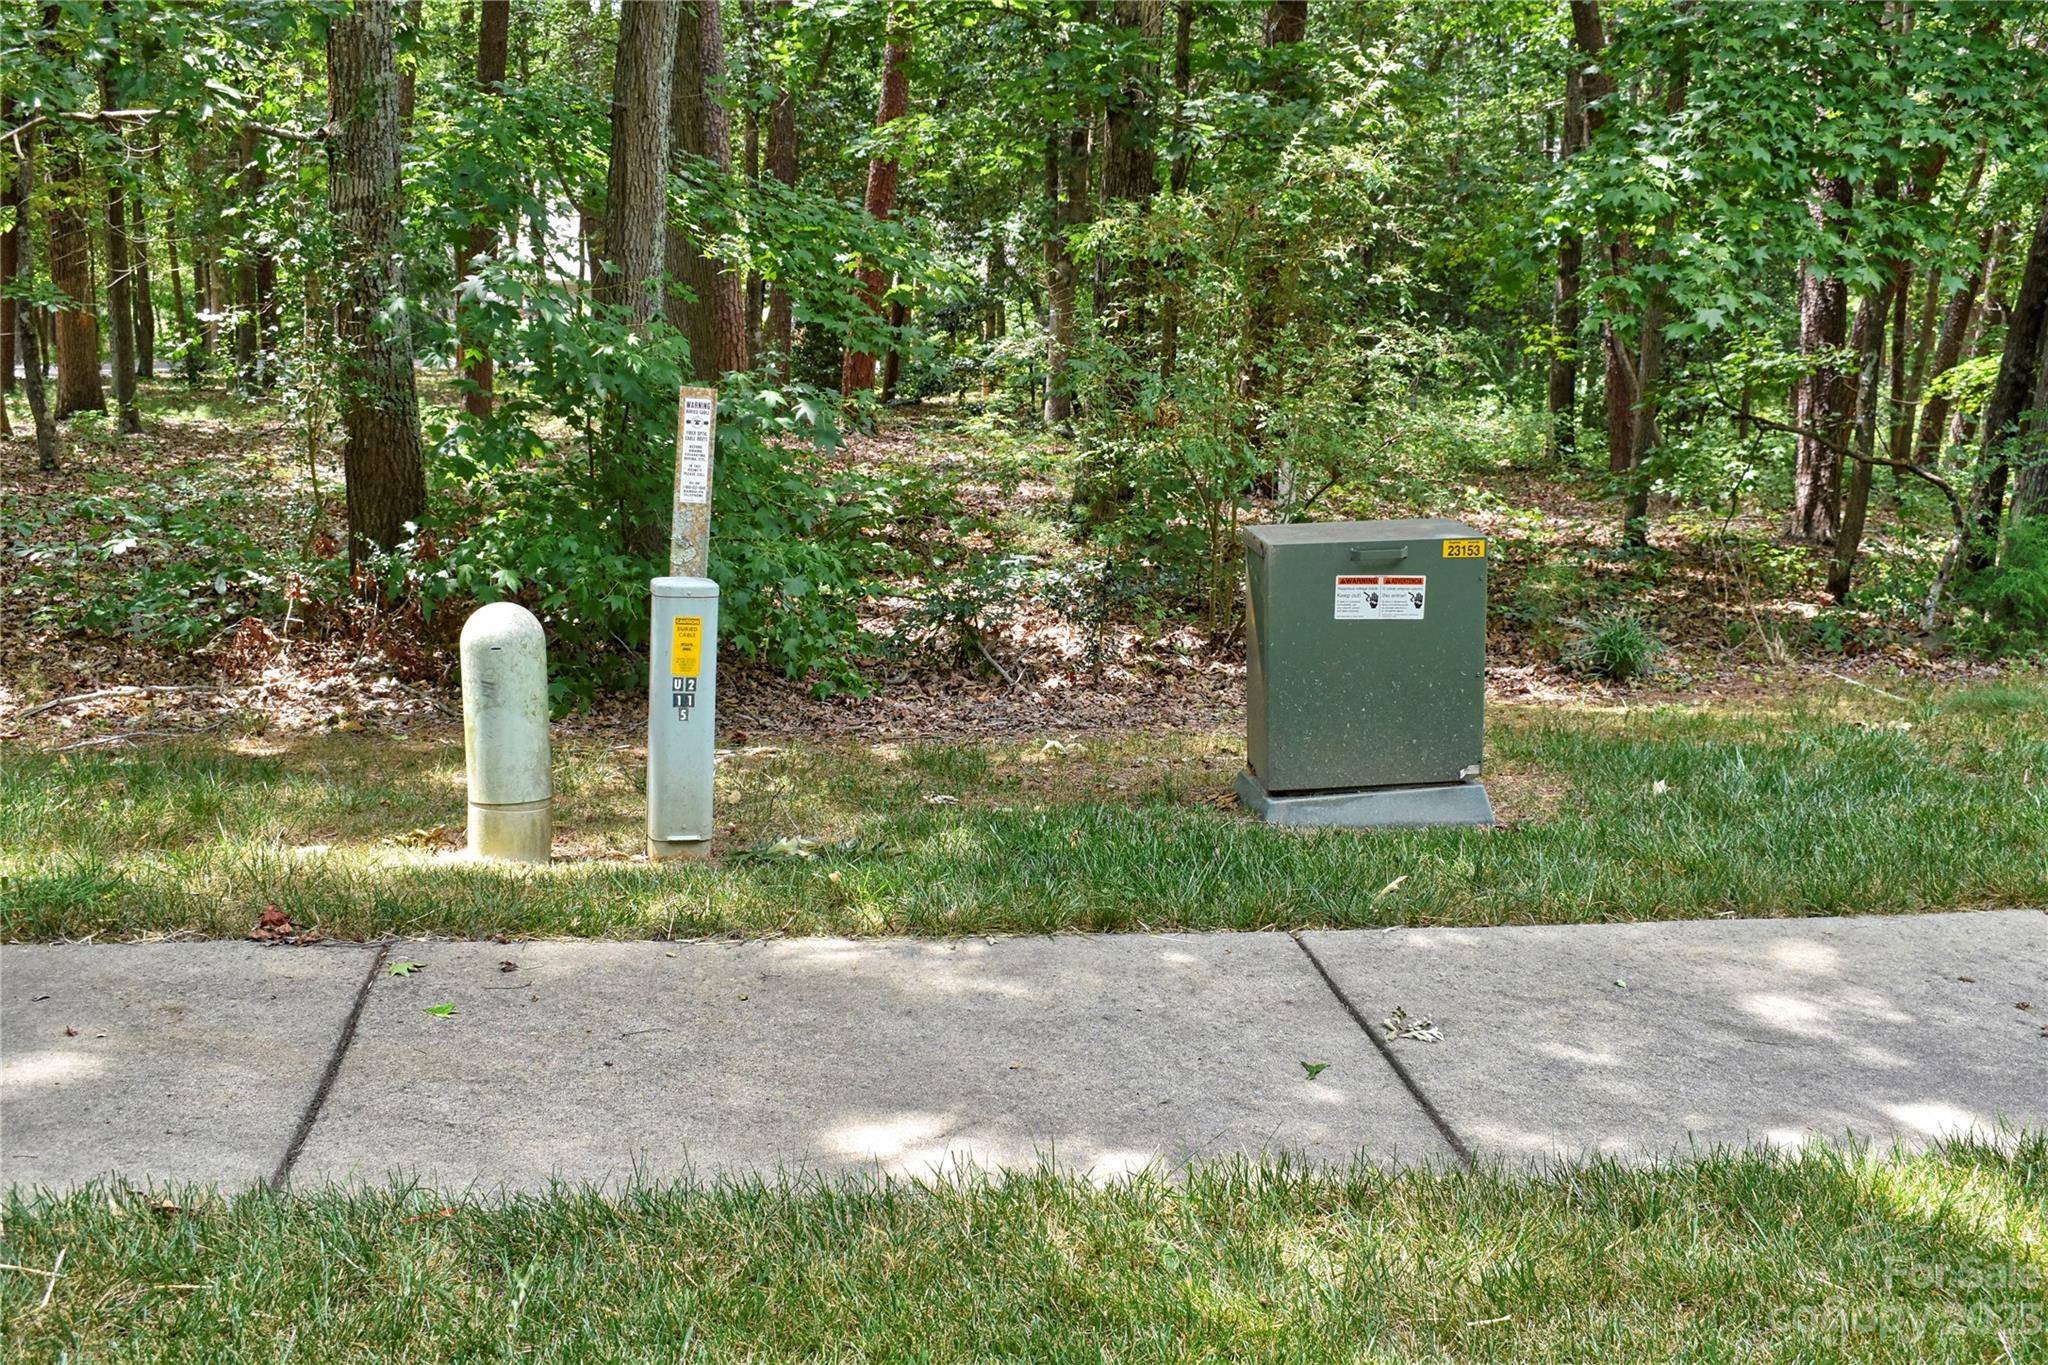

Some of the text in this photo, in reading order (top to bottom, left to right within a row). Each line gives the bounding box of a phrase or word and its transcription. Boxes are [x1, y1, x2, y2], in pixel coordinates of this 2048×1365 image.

[686, 401, 711, 409] WARNING
[1448, 545, 1480, 556] 23153
[680, 710, 687, 720] 5
